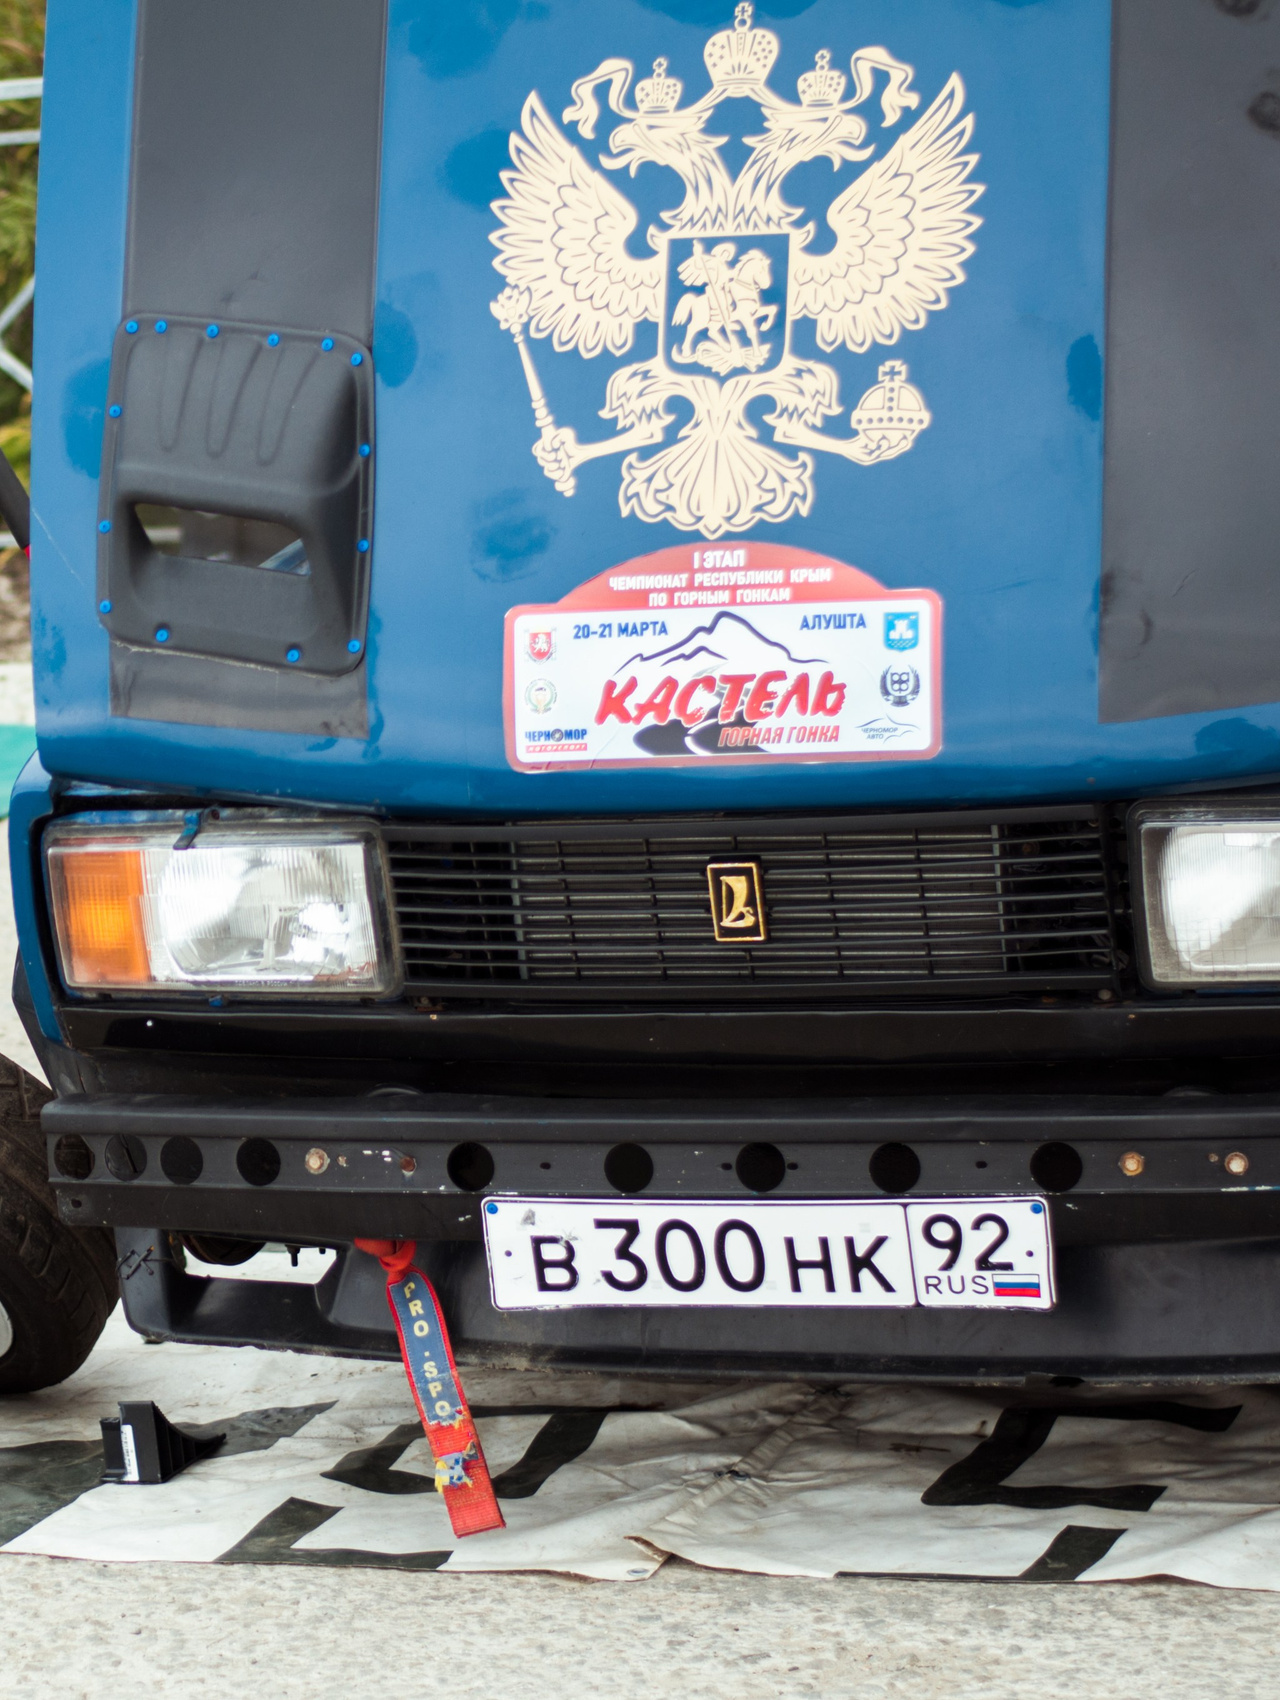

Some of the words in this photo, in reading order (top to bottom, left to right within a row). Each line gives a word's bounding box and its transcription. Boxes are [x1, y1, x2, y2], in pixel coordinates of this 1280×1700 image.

[703, 549, 746, 568] ЭТАП
[609, 573, 689, 591] ЧЕМПИОНАТ
[693, 569, 784, 588] РЕСПУБЛИКИ
[789, 567, 832, 583] КРЫМ
[648, 592, 668, 607] ПО
[673, 589, 730, 606] ГОРНЫМ
[736, 587, 791, 603] ГОНКАМ
[617, 620, 669, 638] МАРТА
[799, 612, 867, 631] АЛУШТА
[593, 669, 848, 727] КАСТЕЛЬ
[717, 726, 785, 747] ГОРНАЯ
[786, 725, 841, 745] ГОНКА
[920, 1213, 1015, 1272] 92
[924, 1274, 990, 1296] RUS
